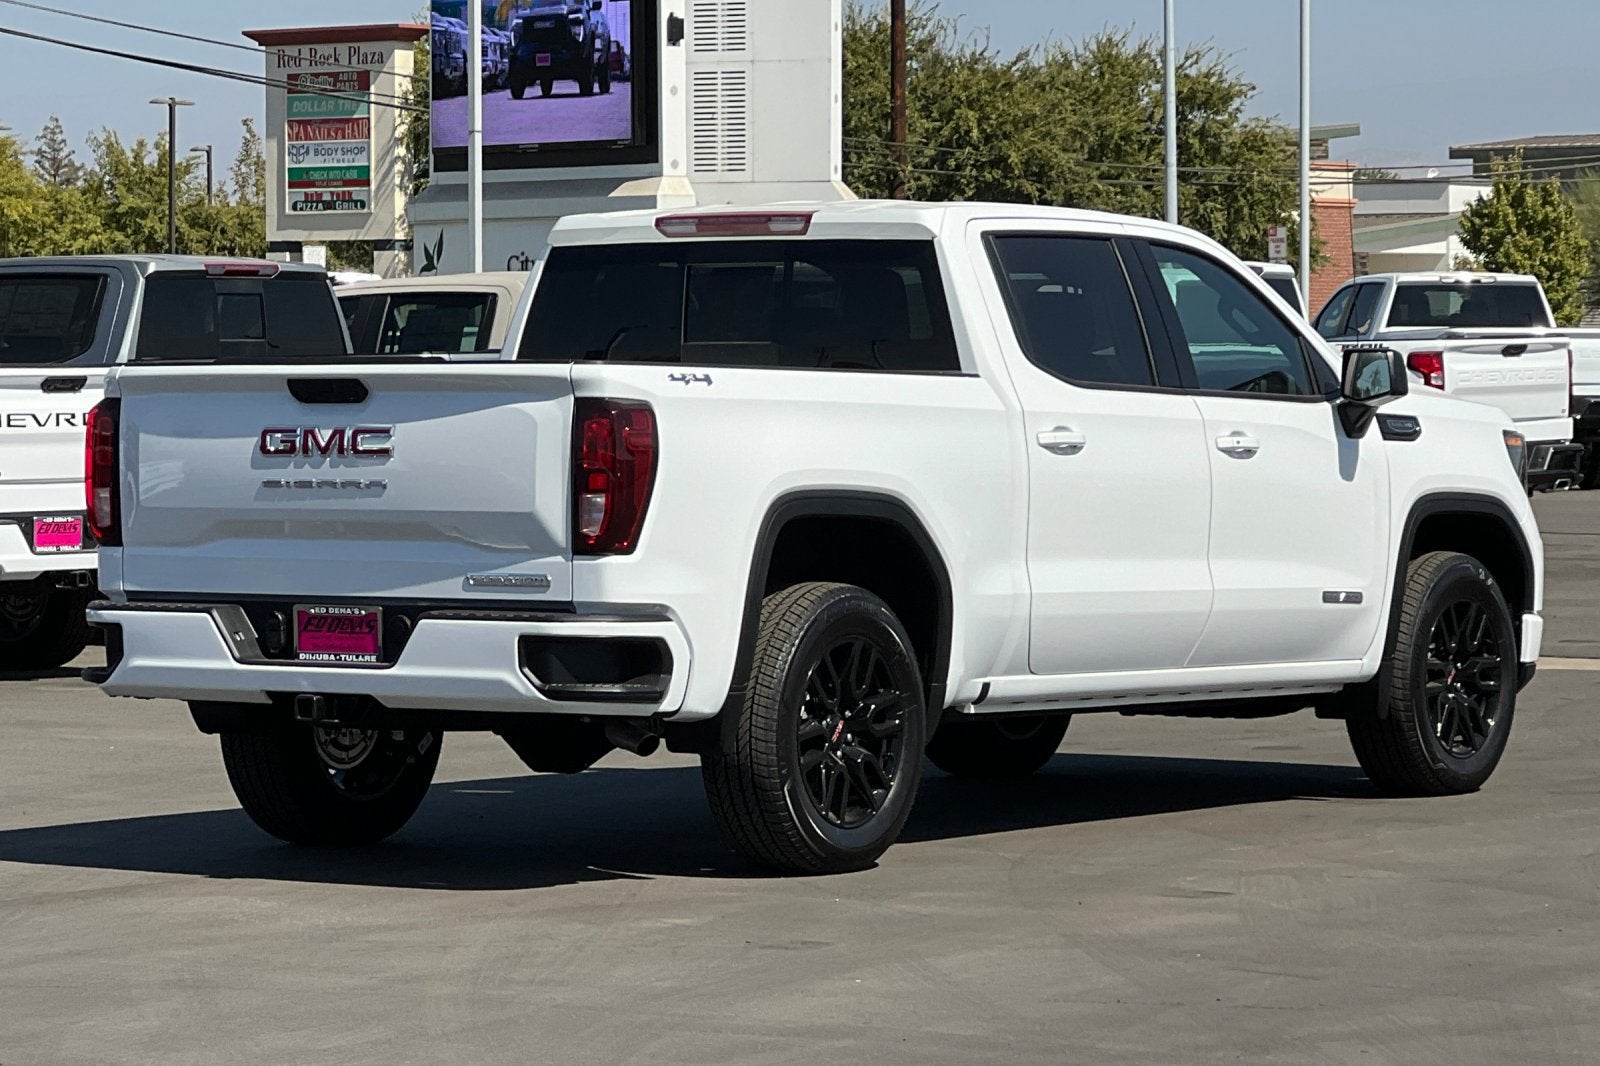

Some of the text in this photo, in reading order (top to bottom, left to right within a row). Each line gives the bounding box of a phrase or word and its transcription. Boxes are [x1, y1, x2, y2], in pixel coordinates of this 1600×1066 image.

[277, 45, 384, 68] Red Rock Plaza
[339, 72, 357, 81] AUTO
[336, 81, 359, 90] PARTS
[292, 100, 335, 113] DOLLAR
[288, 121, 305, 140] SPA
[345, 119, 369, 139] HAIR
[314, 147, 366, 156] BODY SHOP
[297, 200, 363, 211] PIZZA GRILL
[259, 426, 395, 458] GMC
[328, 607, 360, 615] DENA'S
[299, 653, 377, 662] DINUBA TULARE
